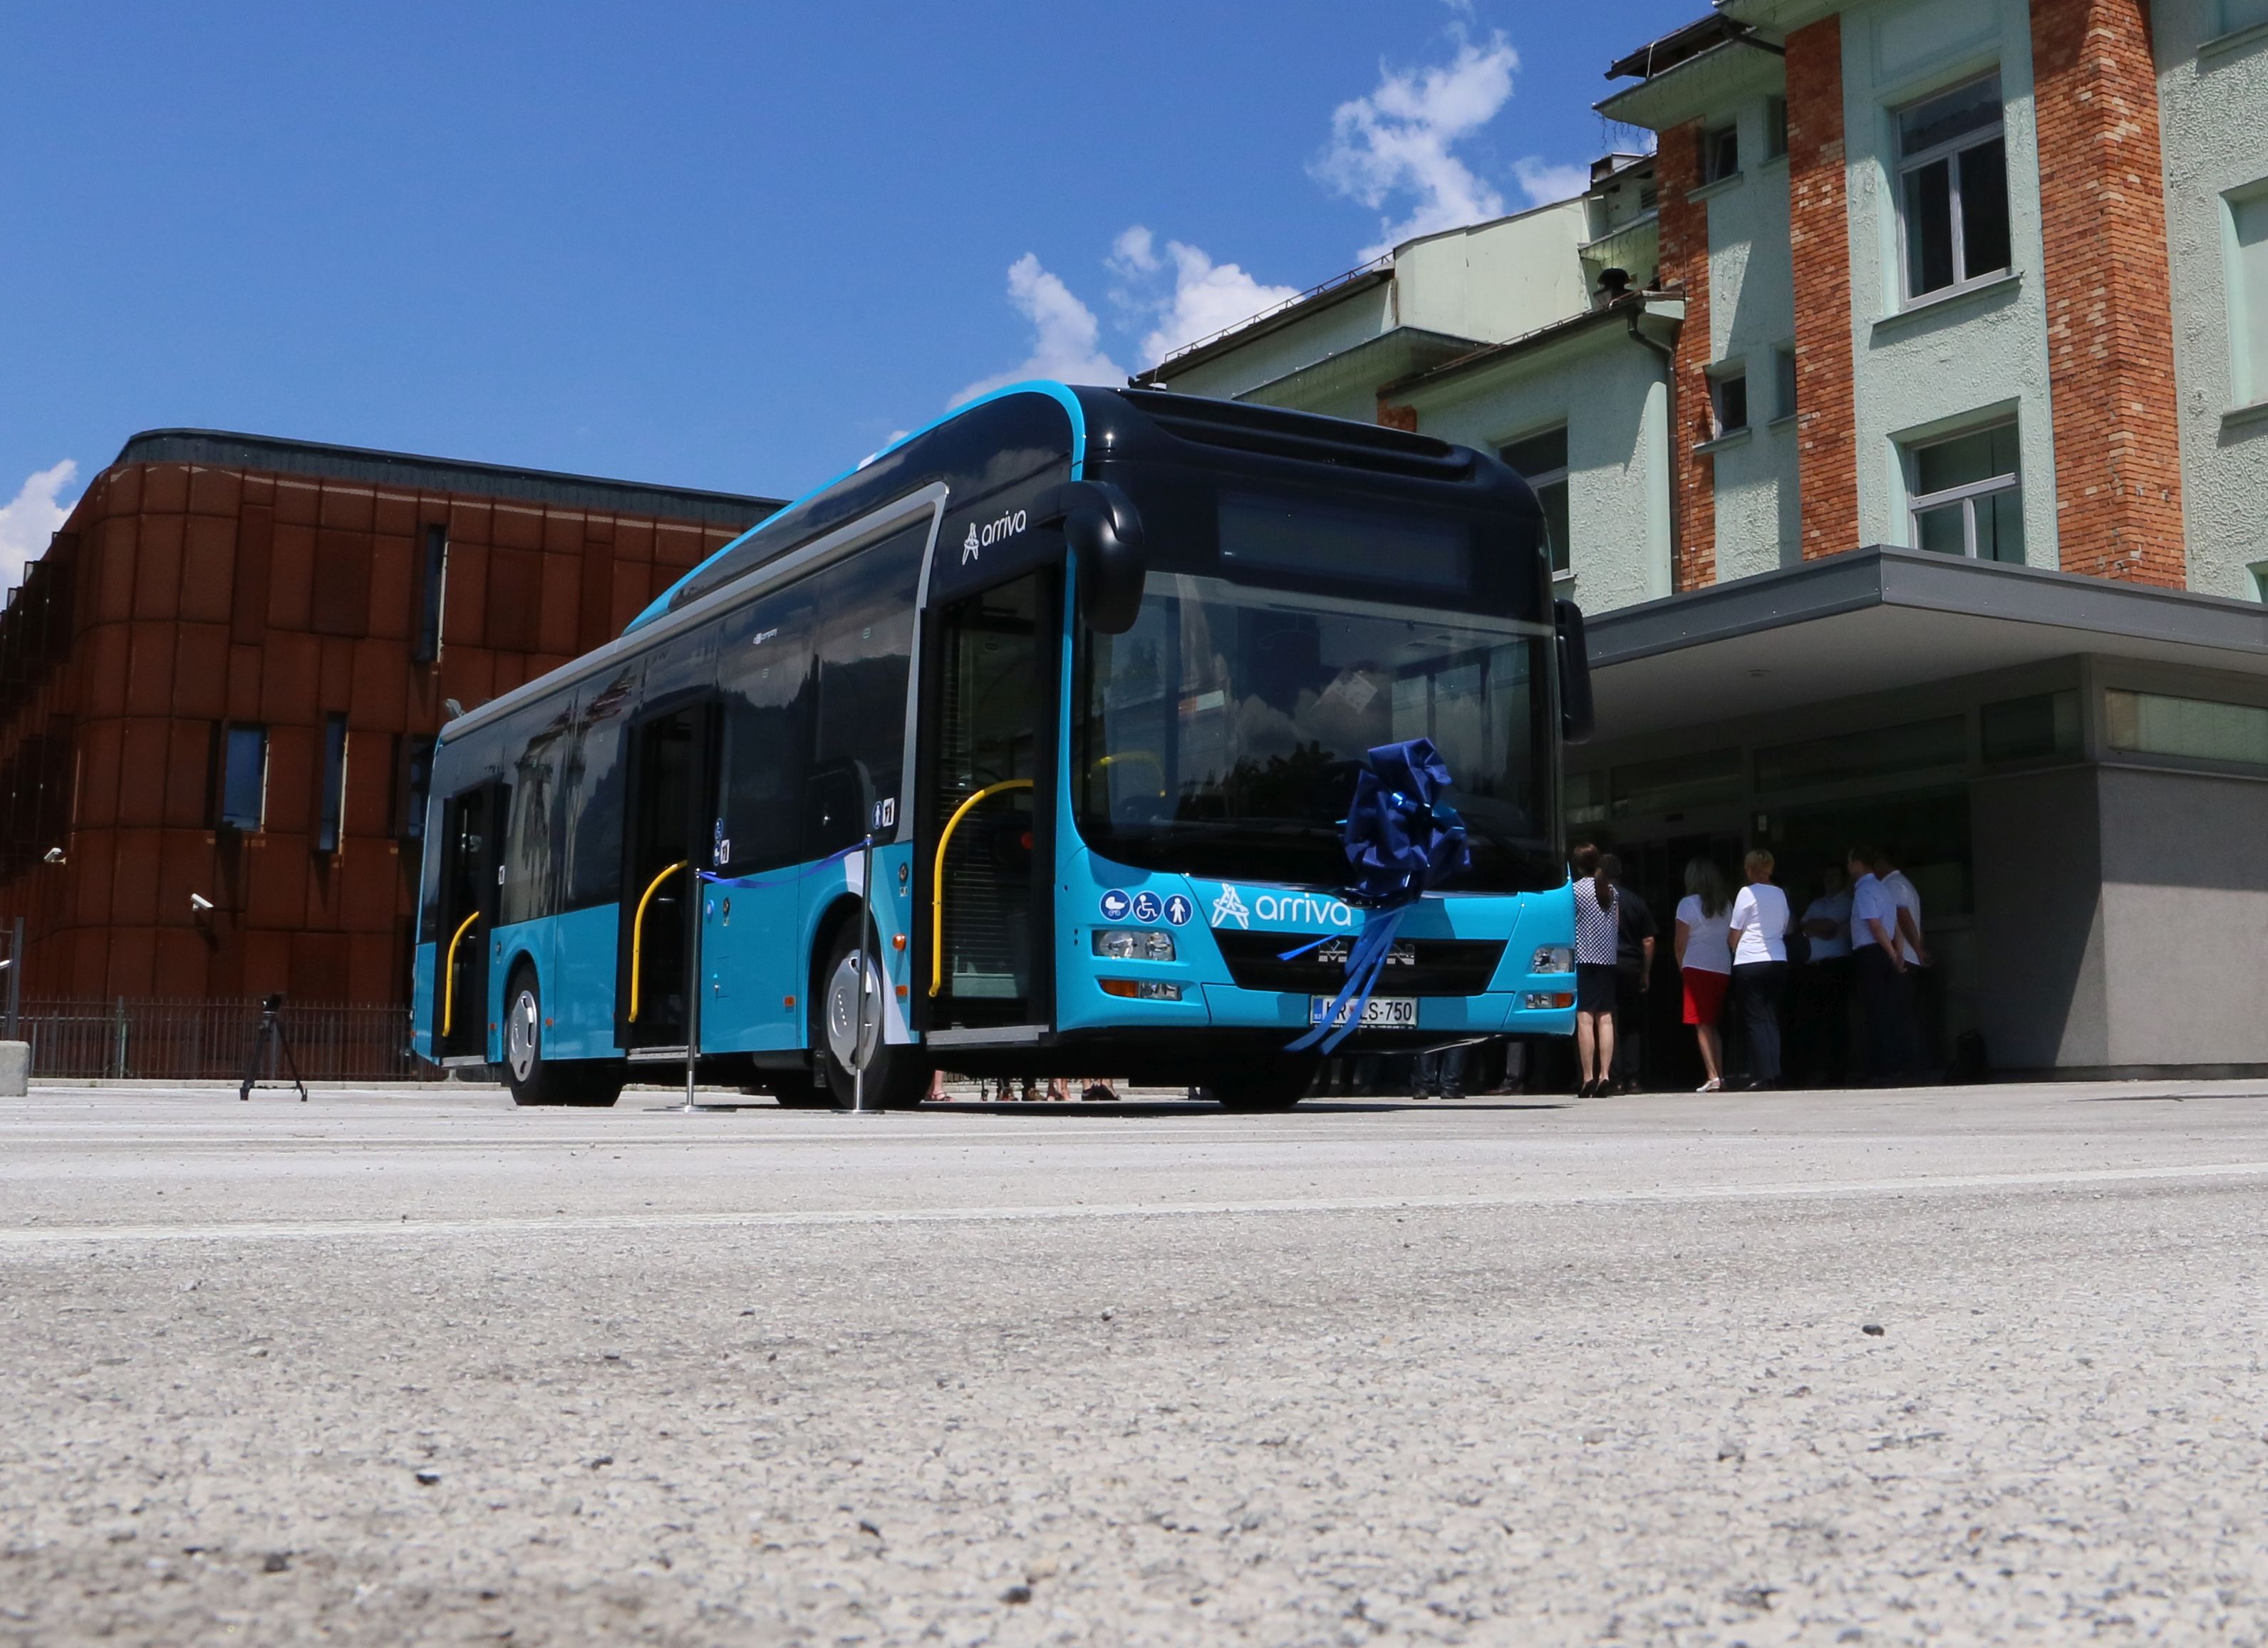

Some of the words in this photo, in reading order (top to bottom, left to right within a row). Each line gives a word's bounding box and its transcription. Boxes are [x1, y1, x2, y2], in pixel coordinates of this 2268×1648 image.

[982, 509, 1026, 546] arriva
[1255, 893, 1351, 926] arriva
[1318, 940, 1415, 965] MN
